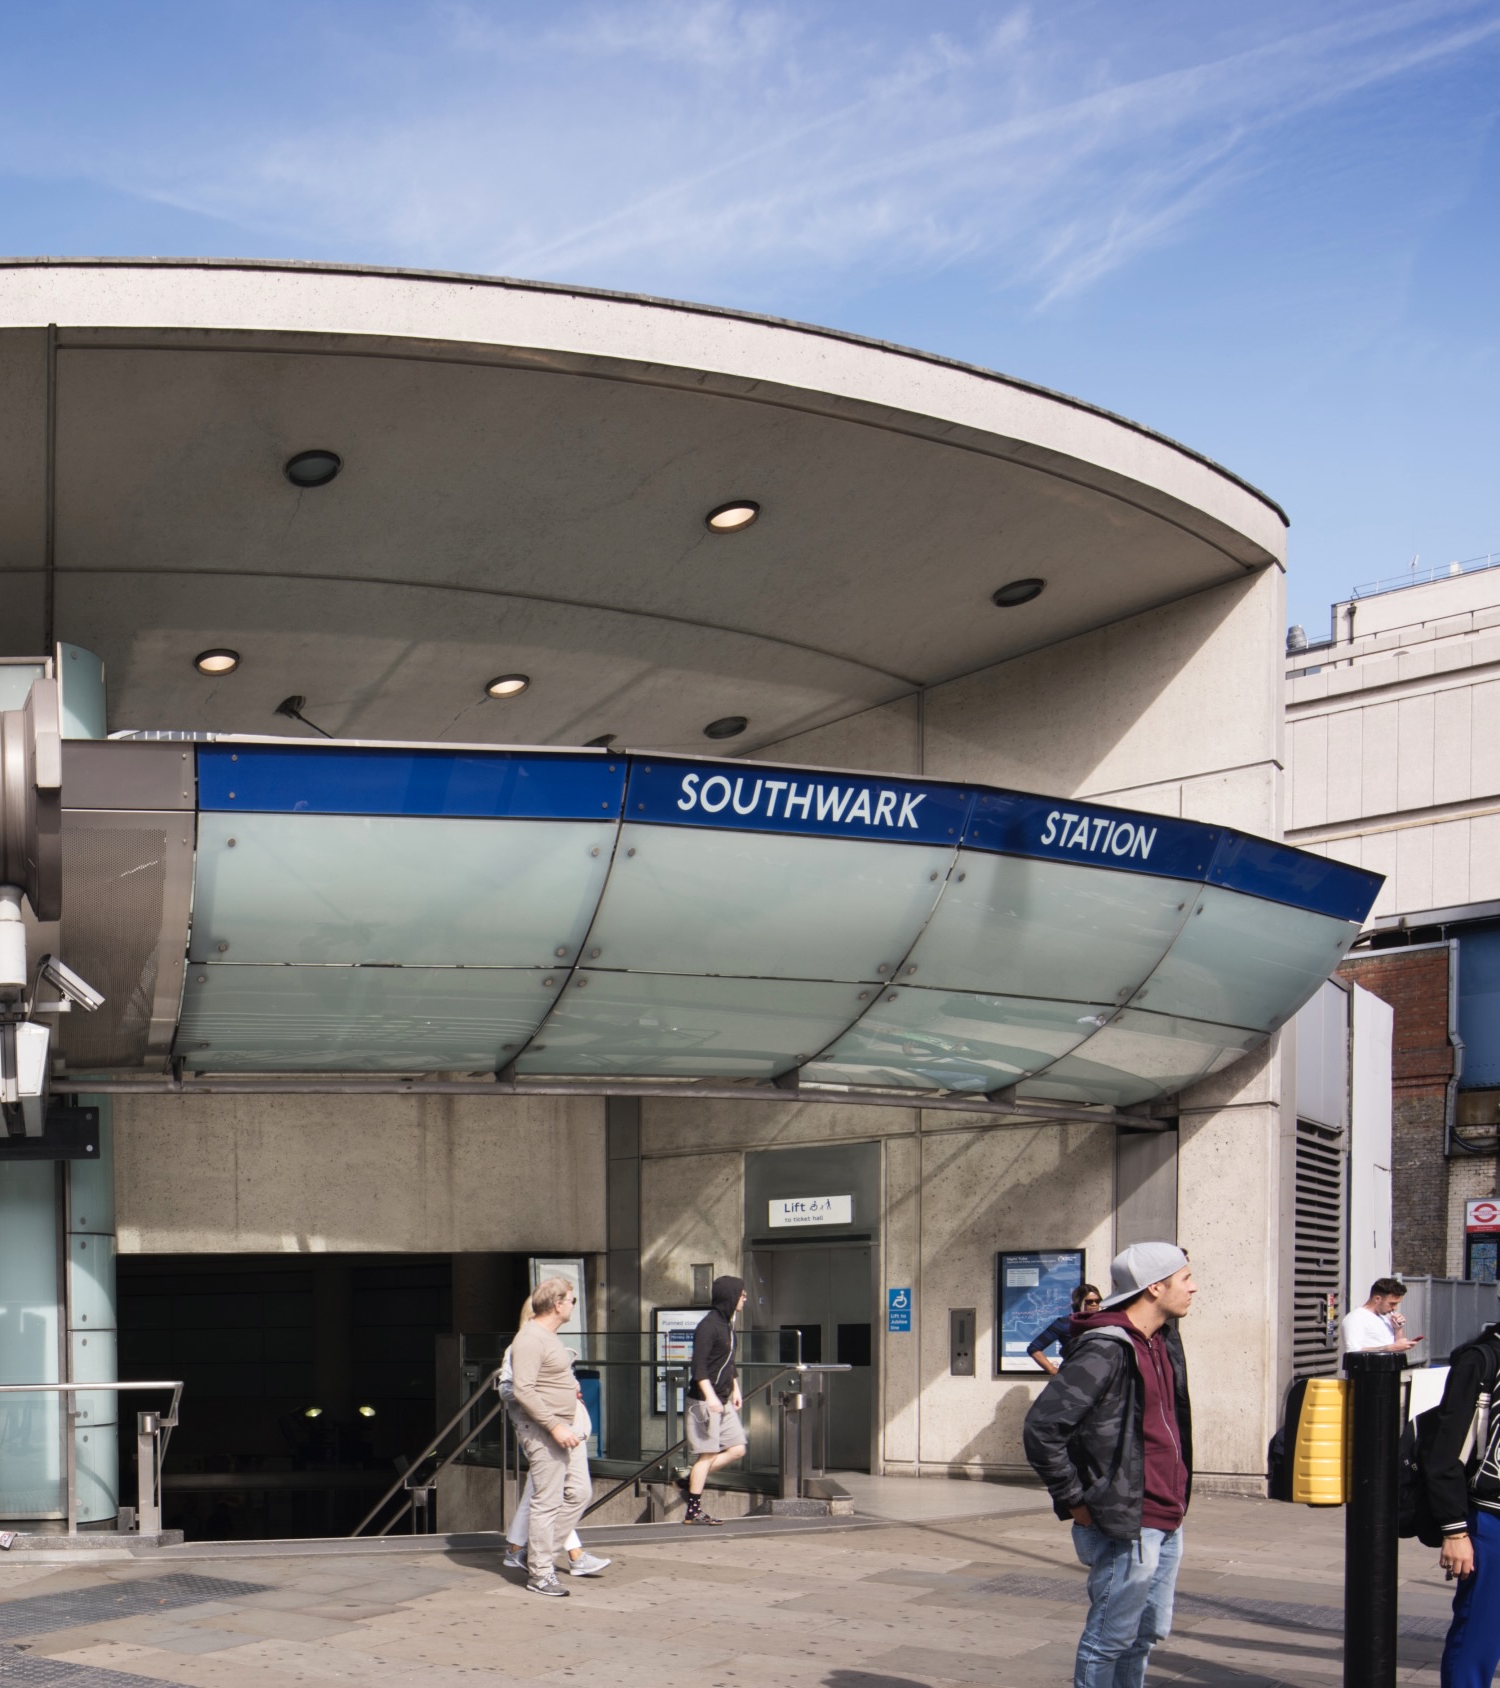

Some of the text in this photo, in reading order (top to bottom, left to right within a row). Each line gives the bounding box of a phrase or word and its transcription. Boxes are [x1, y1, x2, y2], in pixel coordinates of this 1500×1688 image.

[677, 773, 1157, 859] SOUTHWARK STATION
[784, 1202, 806, 1213] Lift
